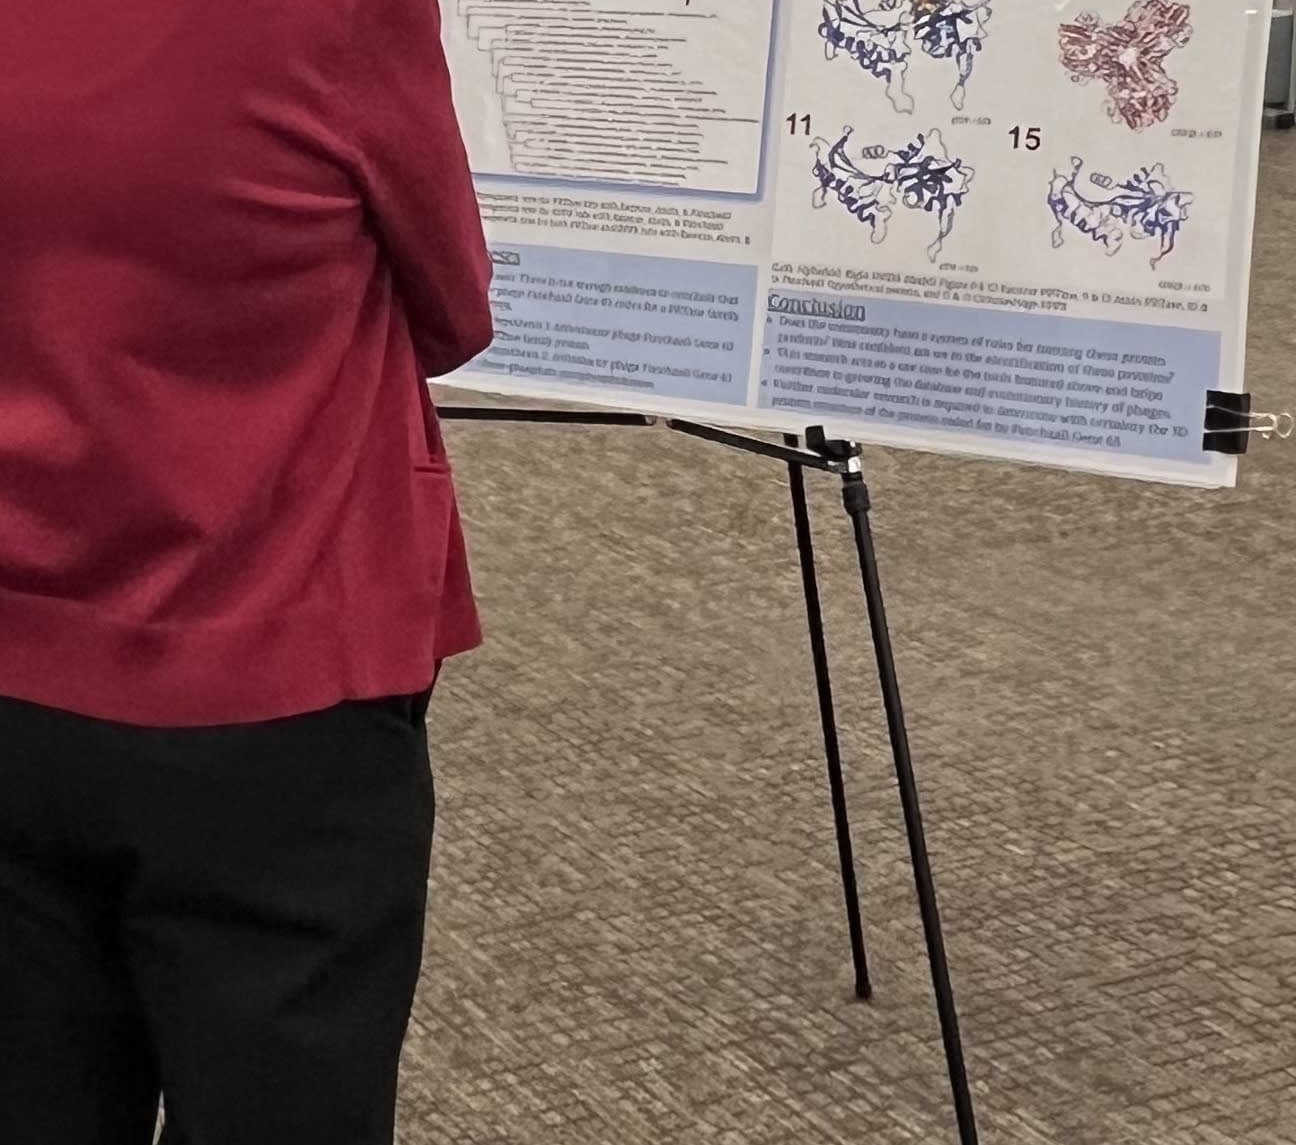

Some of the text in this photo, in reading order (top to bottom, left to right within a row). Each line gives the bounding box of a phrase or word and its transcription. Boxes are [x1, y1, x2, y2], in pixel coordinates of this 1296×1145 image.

[785, 114, 812, 136] 11
[1008, 127, 1042, 151] 15
[768, 293, 866, 322] Conclusion
